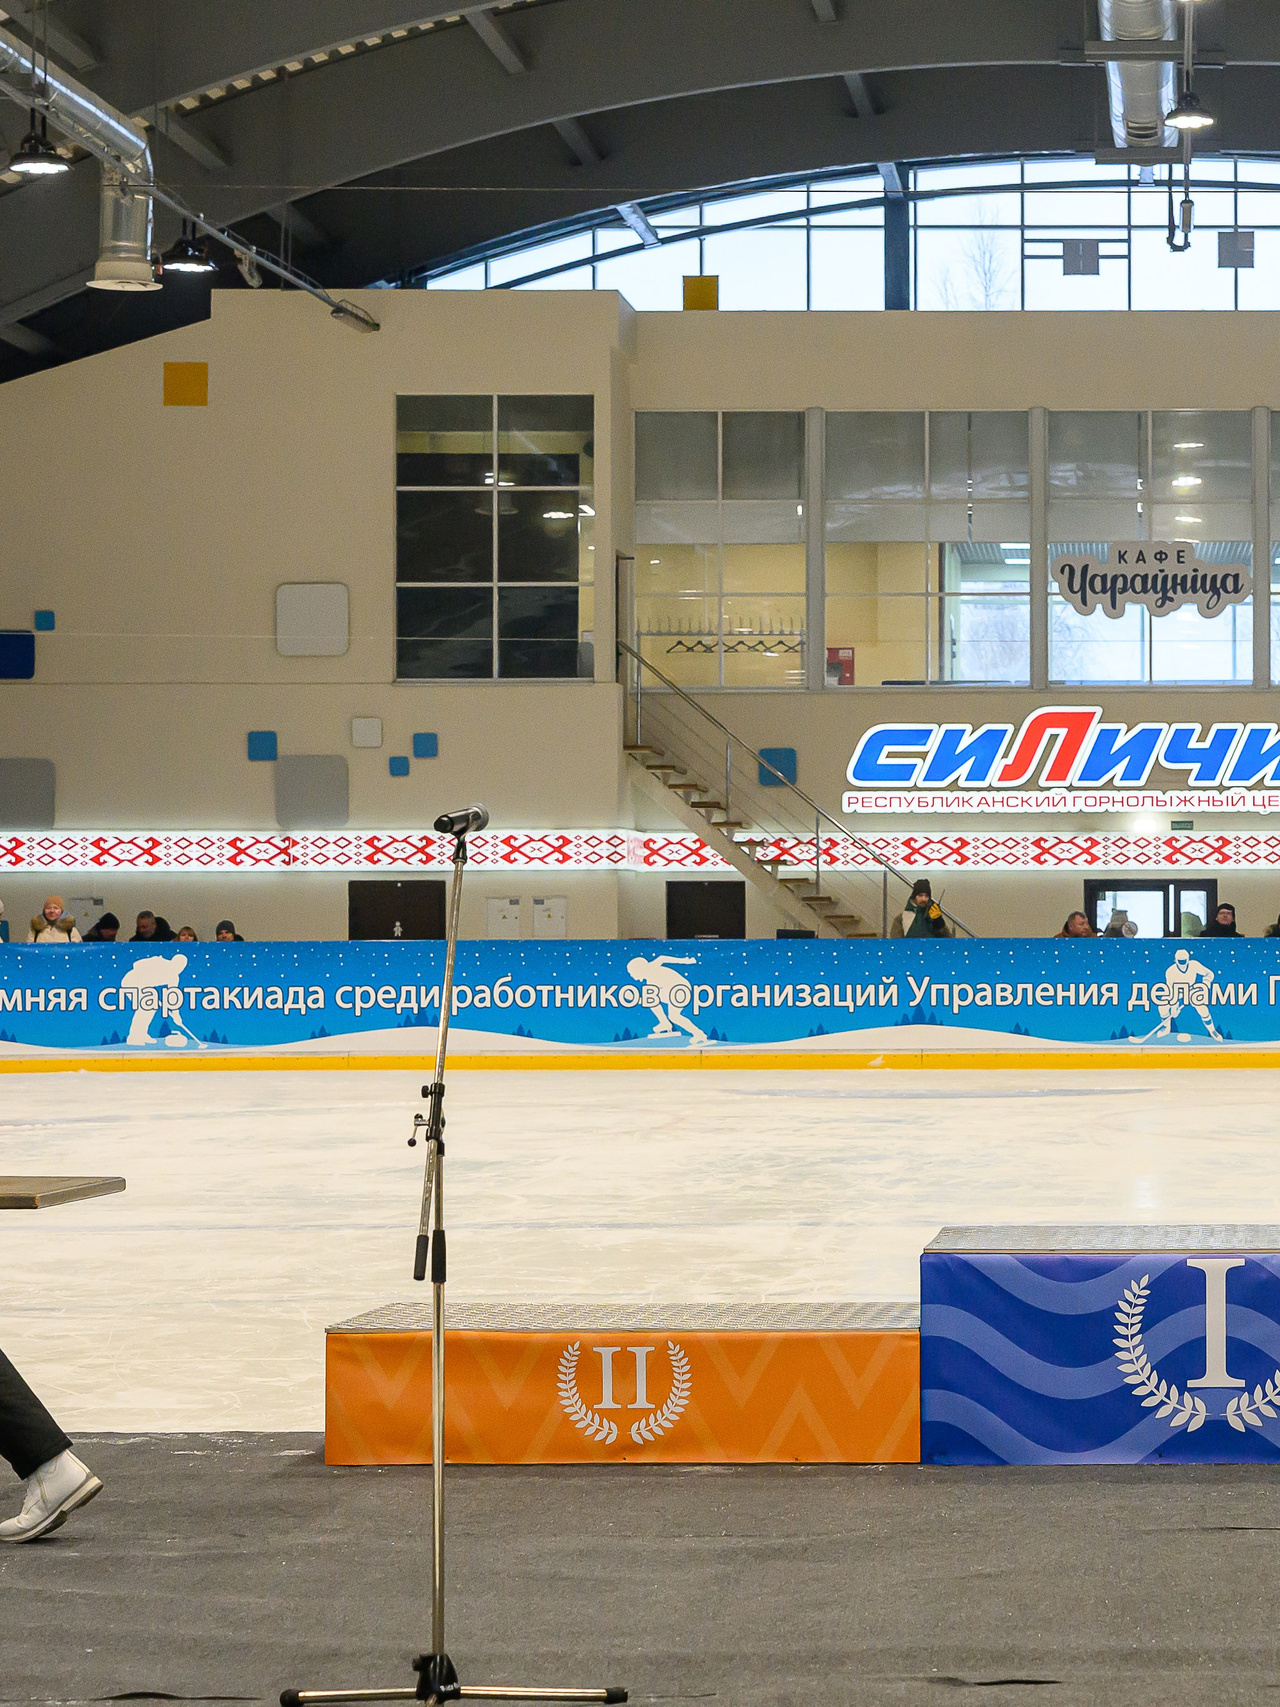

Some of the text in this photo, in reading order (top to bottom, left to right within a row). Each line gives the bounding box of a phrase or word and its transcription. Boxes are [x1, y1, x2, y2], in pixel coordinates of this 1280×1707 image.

[1117, 549, 1186, 565] КАФЕ
[1059, 563, 1245, 611] Чараўніца
[846, 793, 1068, 808] РЕСПУБЛИКАНСКИЙ
[1072, 792, 1247, 807] ГОРНОЛЫЖНЫЙ
[98, 985, 326, 1018] спартакиада
[334, 984, 441, 1017] среди
[450, 975, 662, 1017] работников
[668, 975, 900, 1016] организаций
[906, 975, 1120, 1015] Управления
[1127, 982, 1258, 1012] делами
[1186, 1258, 1246, 1388] I
[592, 1346, 656, 1409] II
